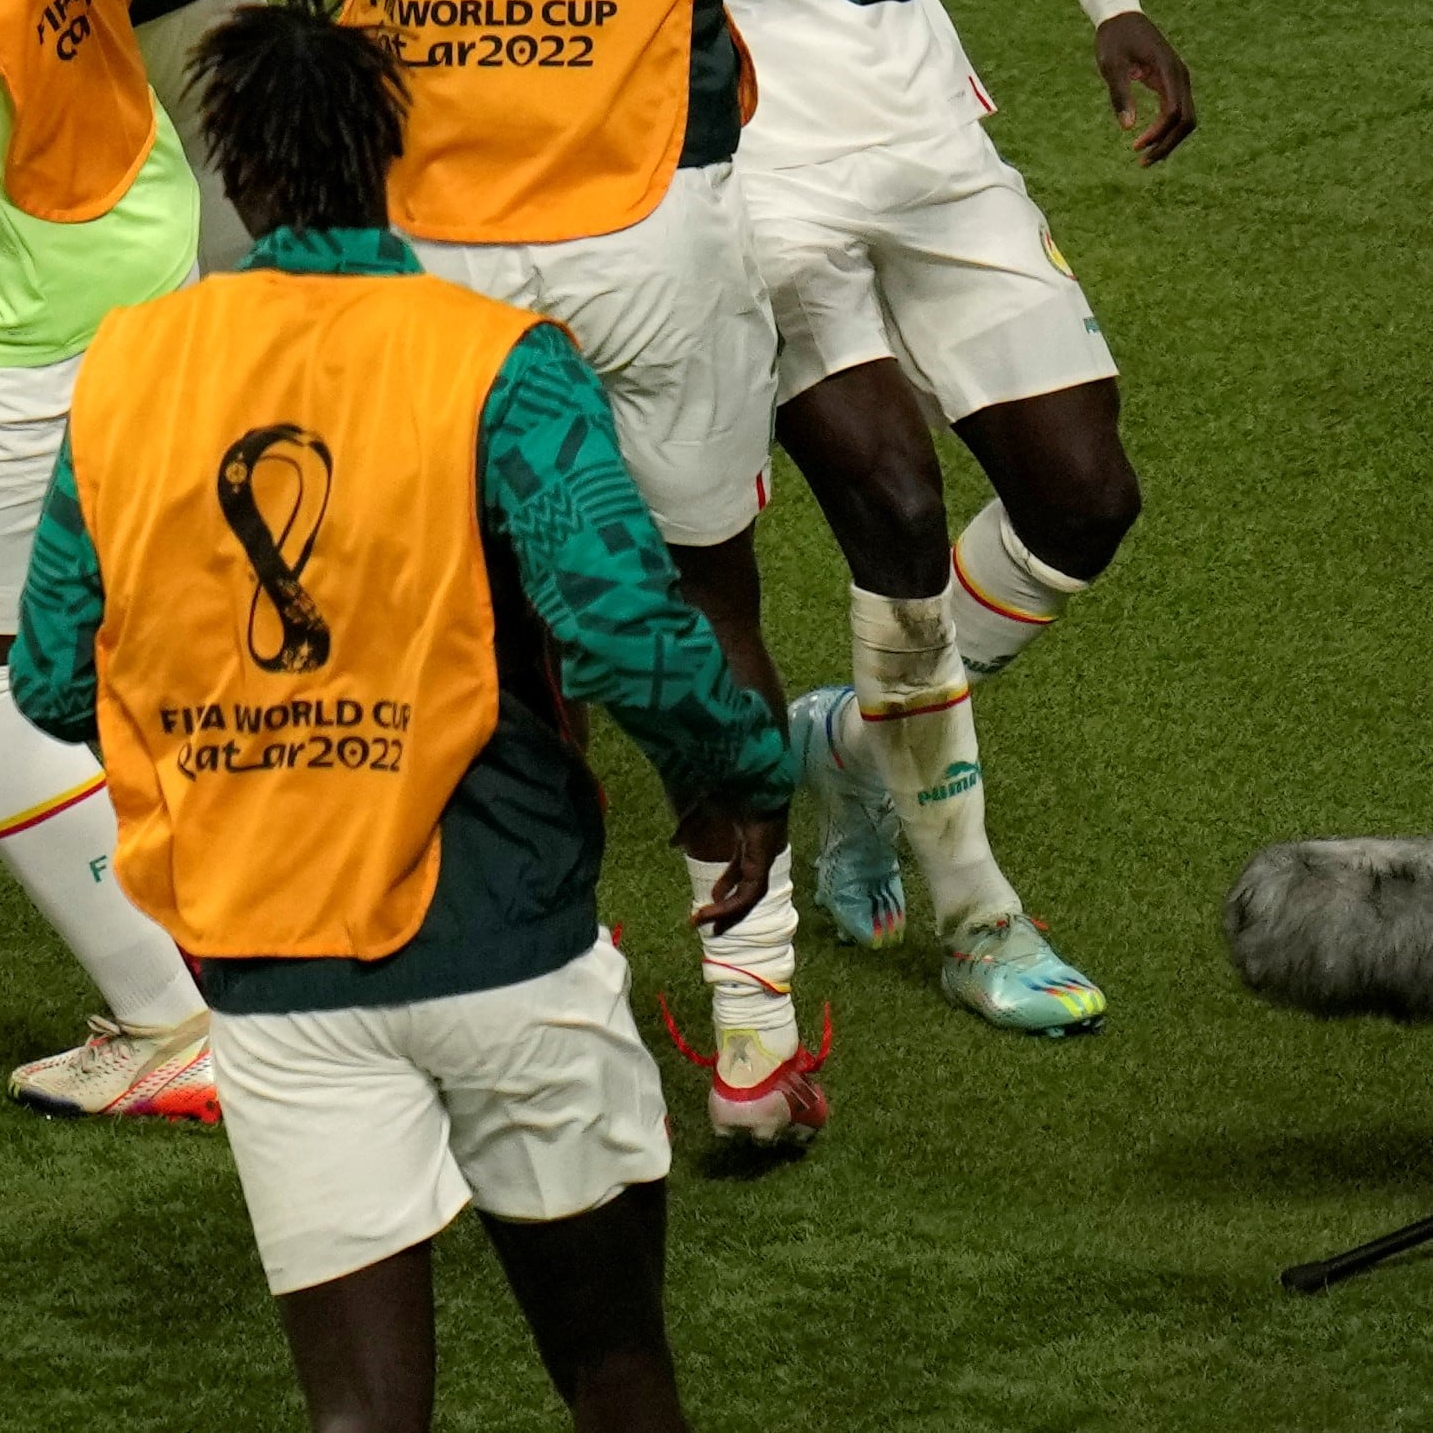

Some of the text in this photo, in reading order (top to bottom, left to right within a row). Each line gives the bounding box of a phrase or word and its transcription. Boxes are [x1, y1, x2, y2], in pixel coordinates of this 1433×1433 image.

[396, 0, 533, 27] WORLD
[541, 0, 618, 27] CUP
[233, 698, 364, 735] WORLD
[373, 700, 411, 733] CUP
